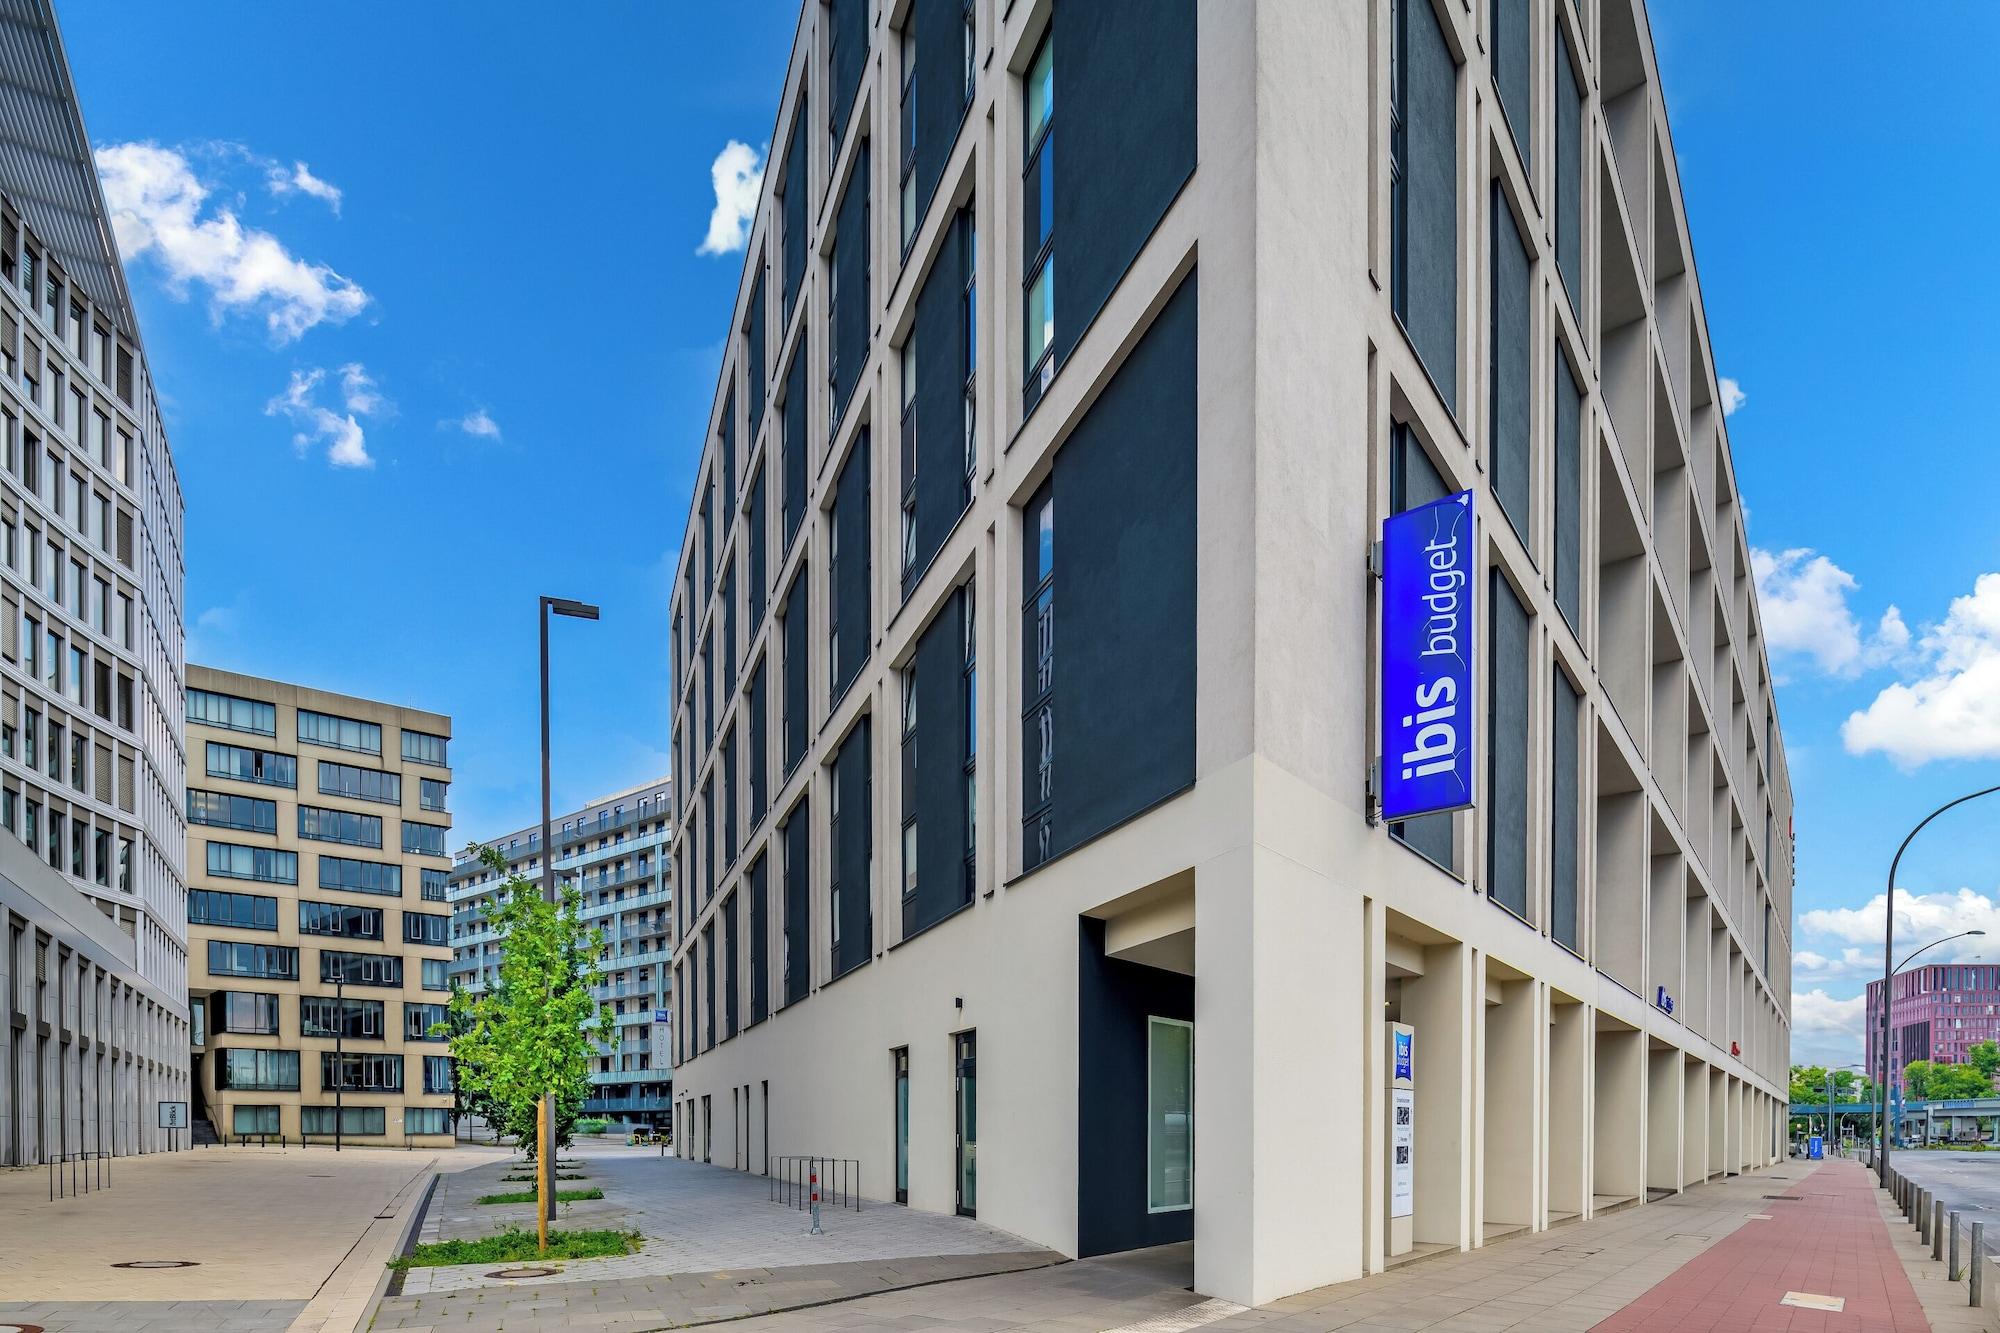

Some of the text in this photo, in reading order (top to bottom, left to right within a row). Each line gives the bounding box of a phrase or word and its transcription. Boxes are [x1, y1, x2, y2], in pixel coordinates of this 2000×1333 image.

[1402, 536, 1466, 780] ibis budget
[658, 1027, 666, 1066] HOTEL
[1398, 1041, 1409, 1057] ibis
